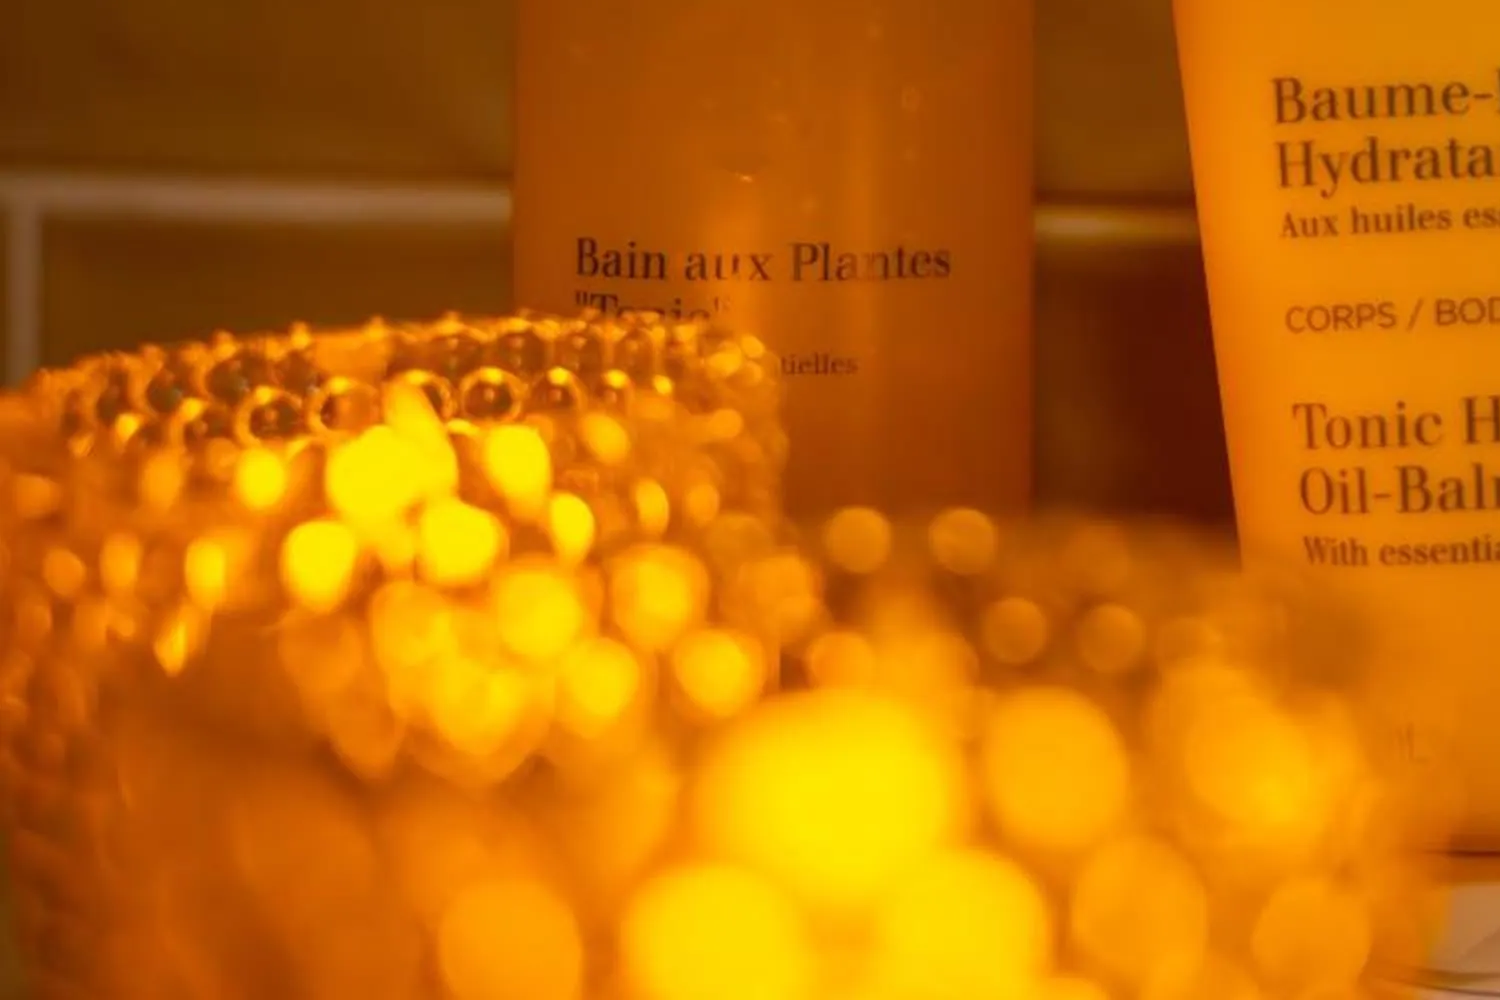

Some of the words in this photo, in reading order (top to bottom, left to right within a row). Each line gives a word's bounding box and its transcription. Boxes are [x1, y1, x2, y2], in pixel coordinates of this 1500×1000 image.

[1280, 213, 1339, 239] Aux
[1350, 204, 1452, 235] huiles
[576, 237, 667, 280] Bain
[684, 251, 774, 281] aux
[790, 242, 951, 283] Plantes
[1285, 303, 1397, 334] CORPS
[1293, 400, 1443, 451] Tonic
[1303, 534, 1370, 567] With
